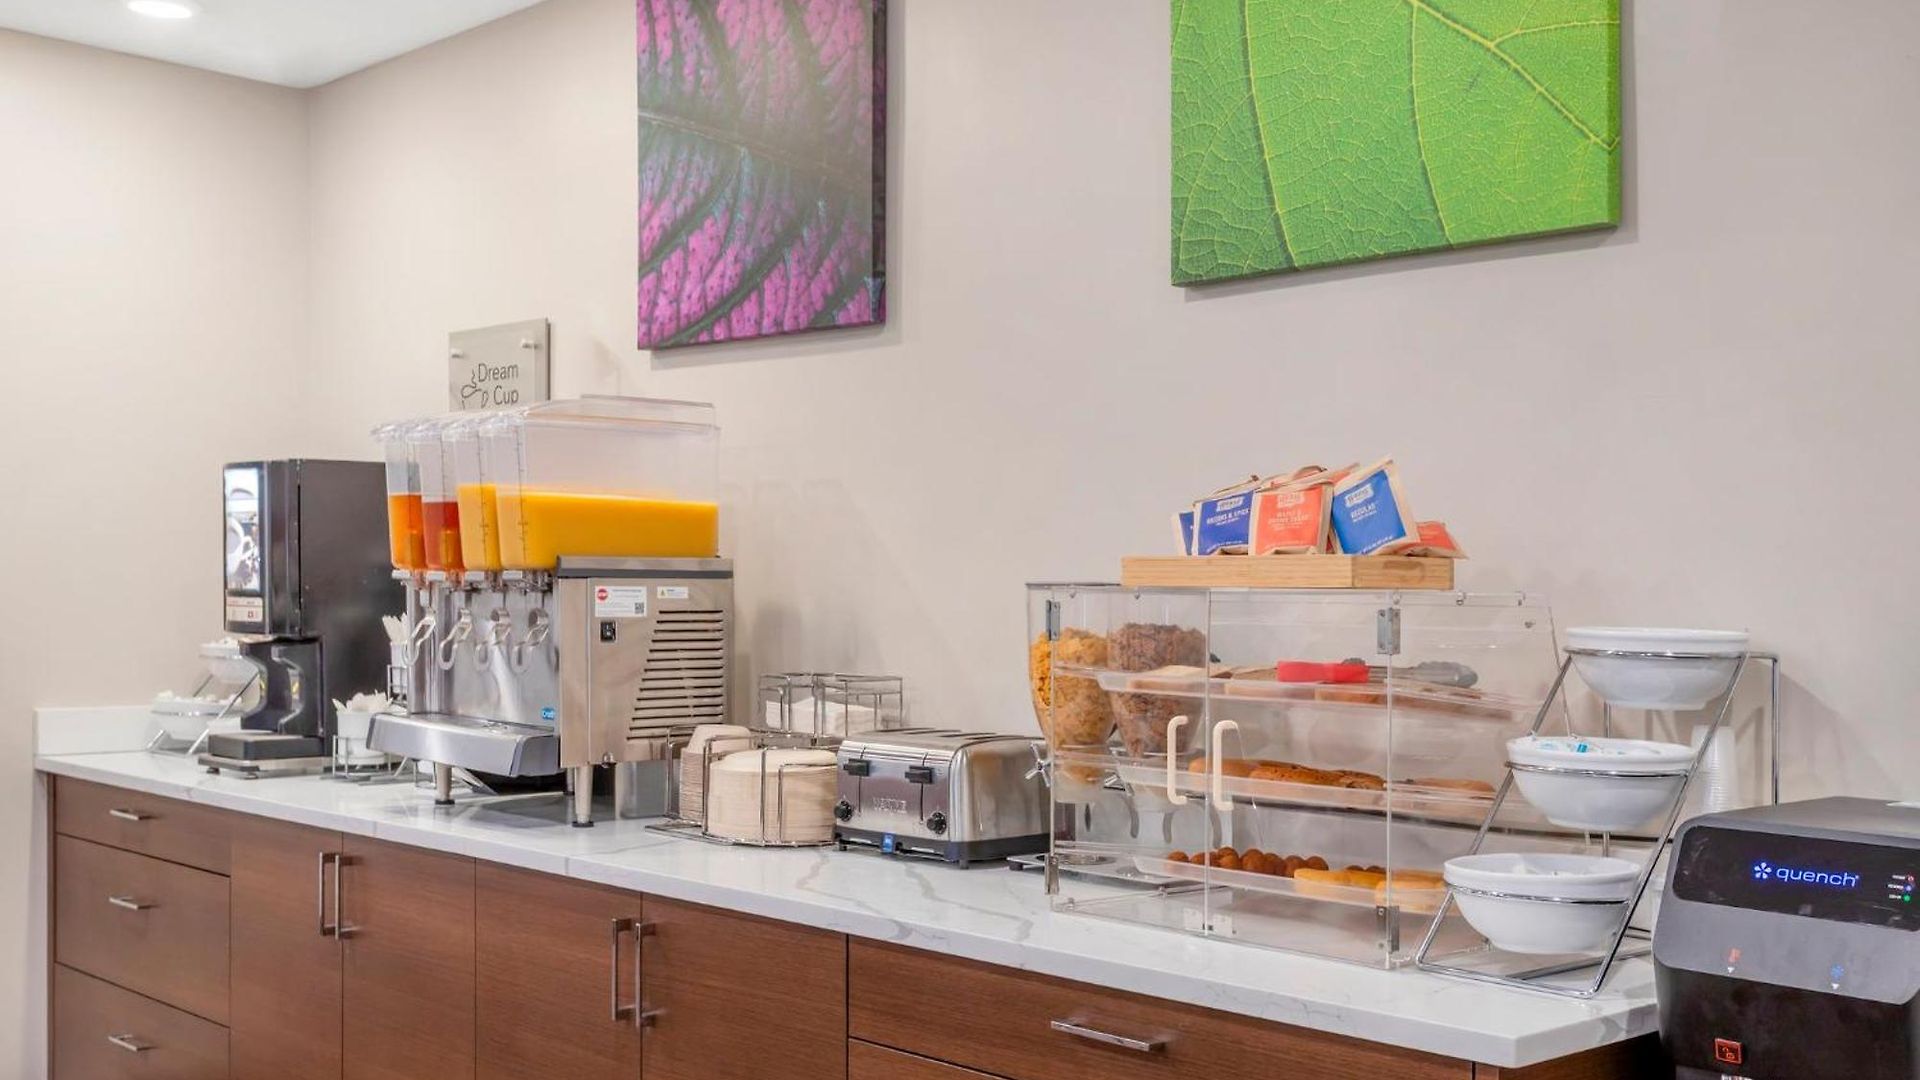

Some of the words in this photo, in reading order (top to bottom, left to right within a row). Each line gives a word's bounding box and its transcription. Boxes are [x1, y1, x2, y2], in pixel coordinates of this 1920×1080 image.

[478, 362, 519, 383] Dream
[493, 384, 519, 406] Cup
[1776, 867, 1857, 888] quench
